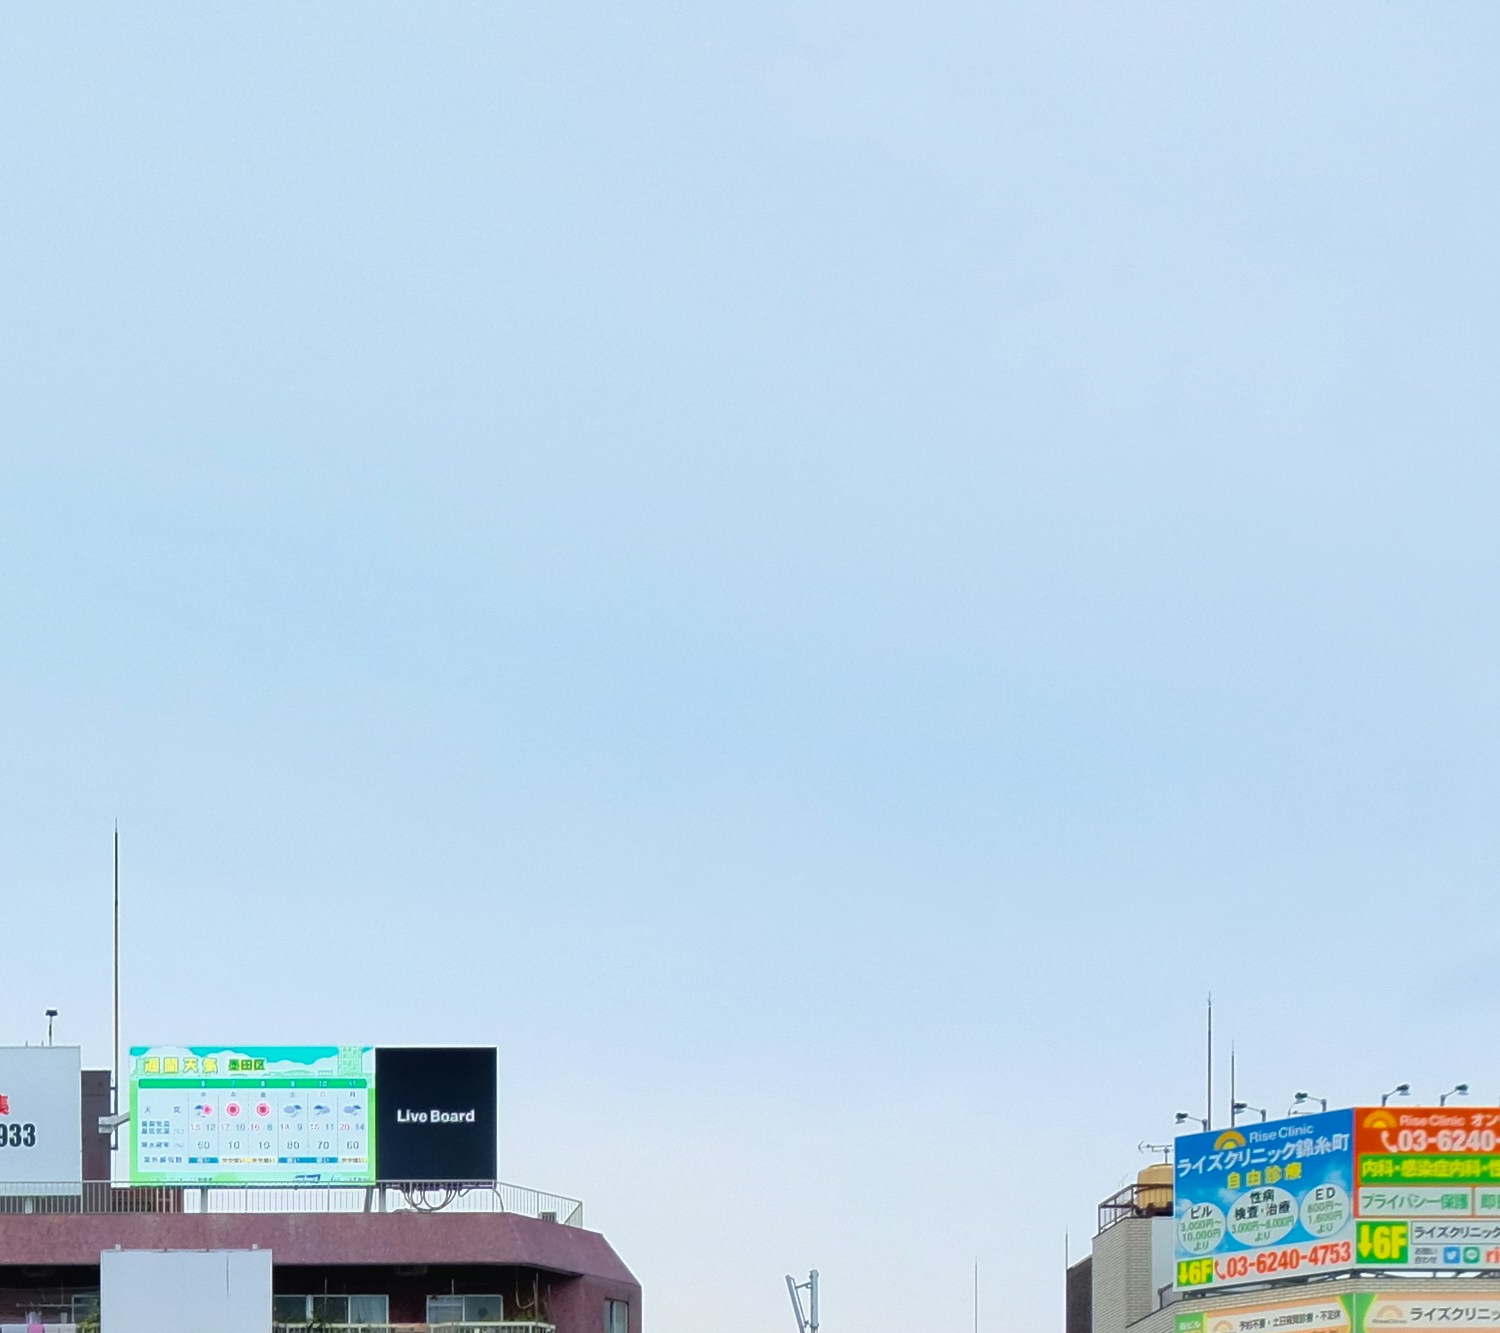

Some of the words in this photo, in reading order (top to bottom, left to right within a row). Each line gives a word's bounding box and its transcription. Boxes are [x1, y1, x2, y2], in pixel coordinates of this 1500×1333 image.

[228, 1059, 266, 1071] 墨田区
[397, 1109, 428, 1123] Live
[430, 1109, 475, 1123] Board
[1249, 1130, 1277, 1143] Rise
[1278, 1125, 1314, 1139] Clinic
[317, 1140, 330, 1150] 70
[1177, 1133, 1350, 1178] ライズクリニック錦糸町
[1249, 1188, 1275, 1203] 性病
[1315, 1186, 1336, 1201] ED
[1362, 1193, 1468, 1210] プライバシー保護
[1235, 1200, 1291, 1221] 検査・治療
[1372, 1225, 1408, 1260] 6F
[1226, 1241, 1351, 1278] 03-6240-4753
[1188, 1259, 1213, 1285] 6F
